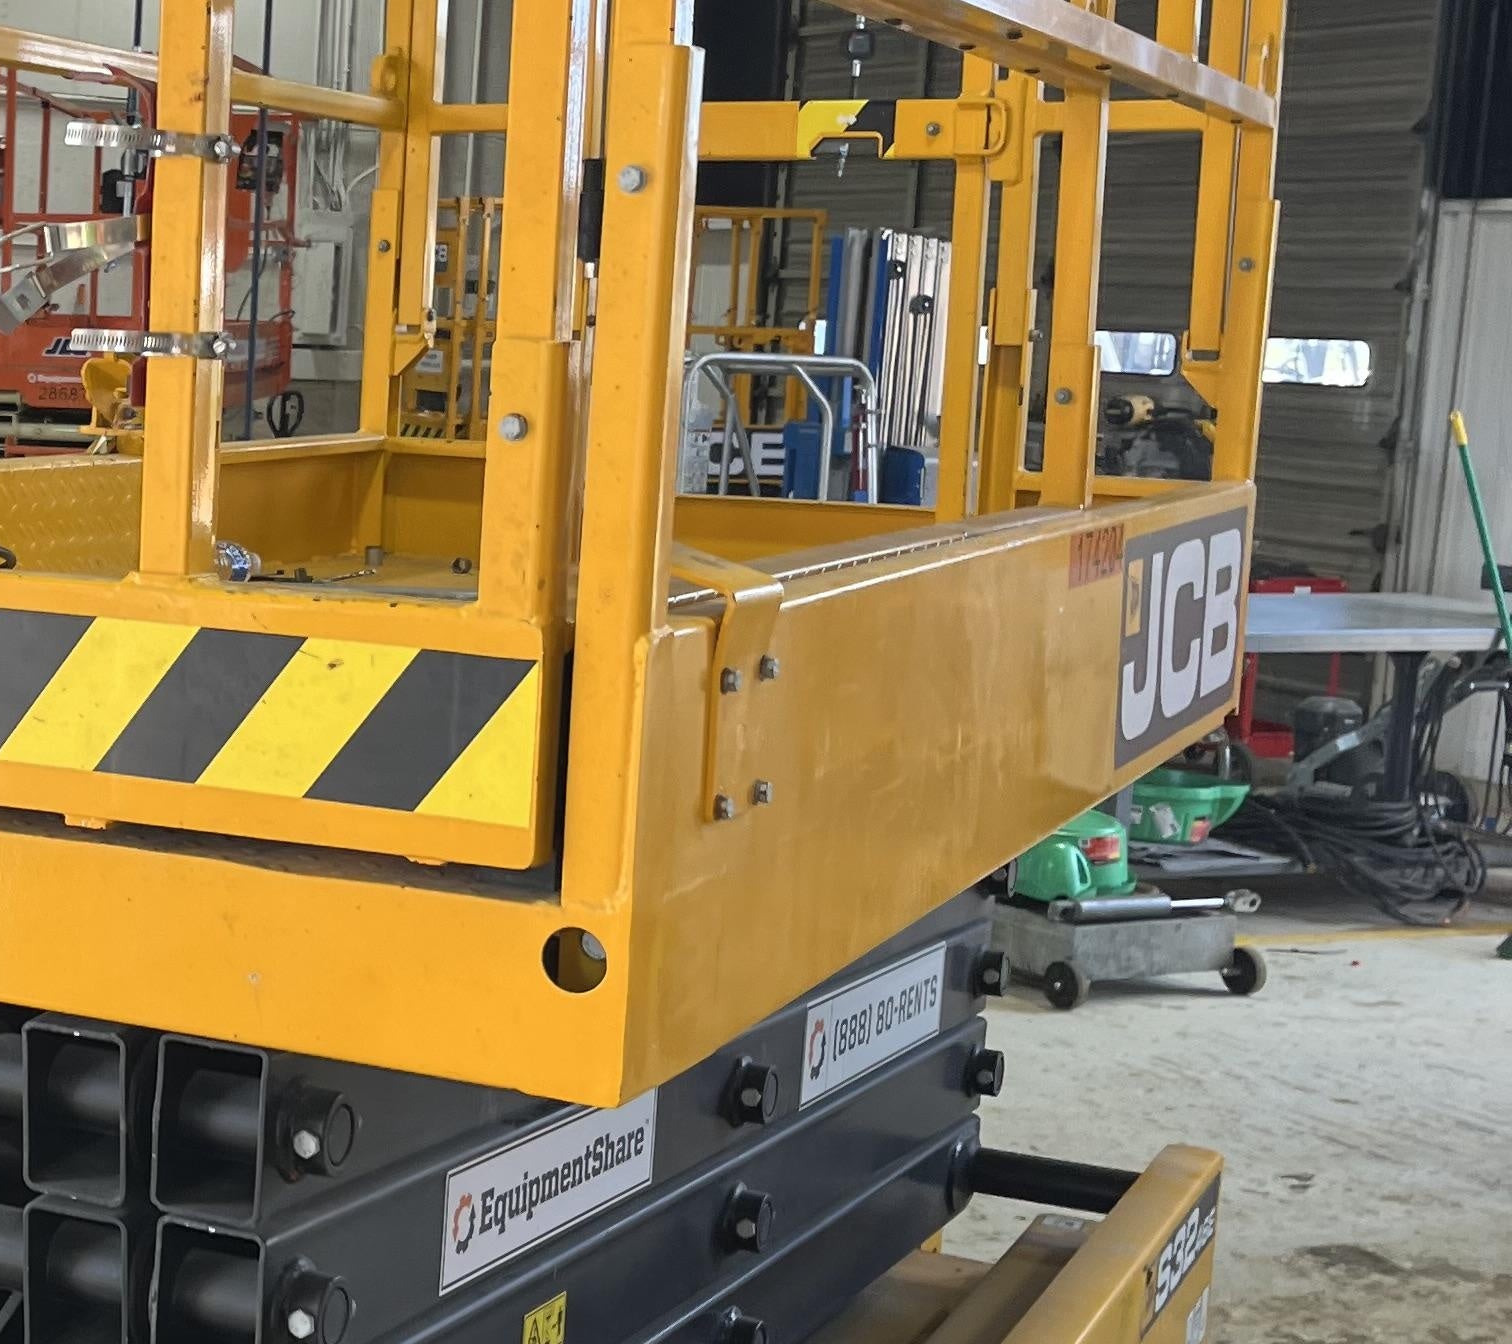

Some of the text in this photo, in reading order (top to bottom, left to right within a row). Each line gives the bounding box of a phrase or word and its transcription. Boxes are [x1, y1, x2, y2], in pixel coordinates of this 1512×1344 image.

[1121, 528, 1242, 741] JCB
[832, 974, 938, 1062] (888) 80-RENTS
[478, 1126, 645, 1236] EquipmentShare
